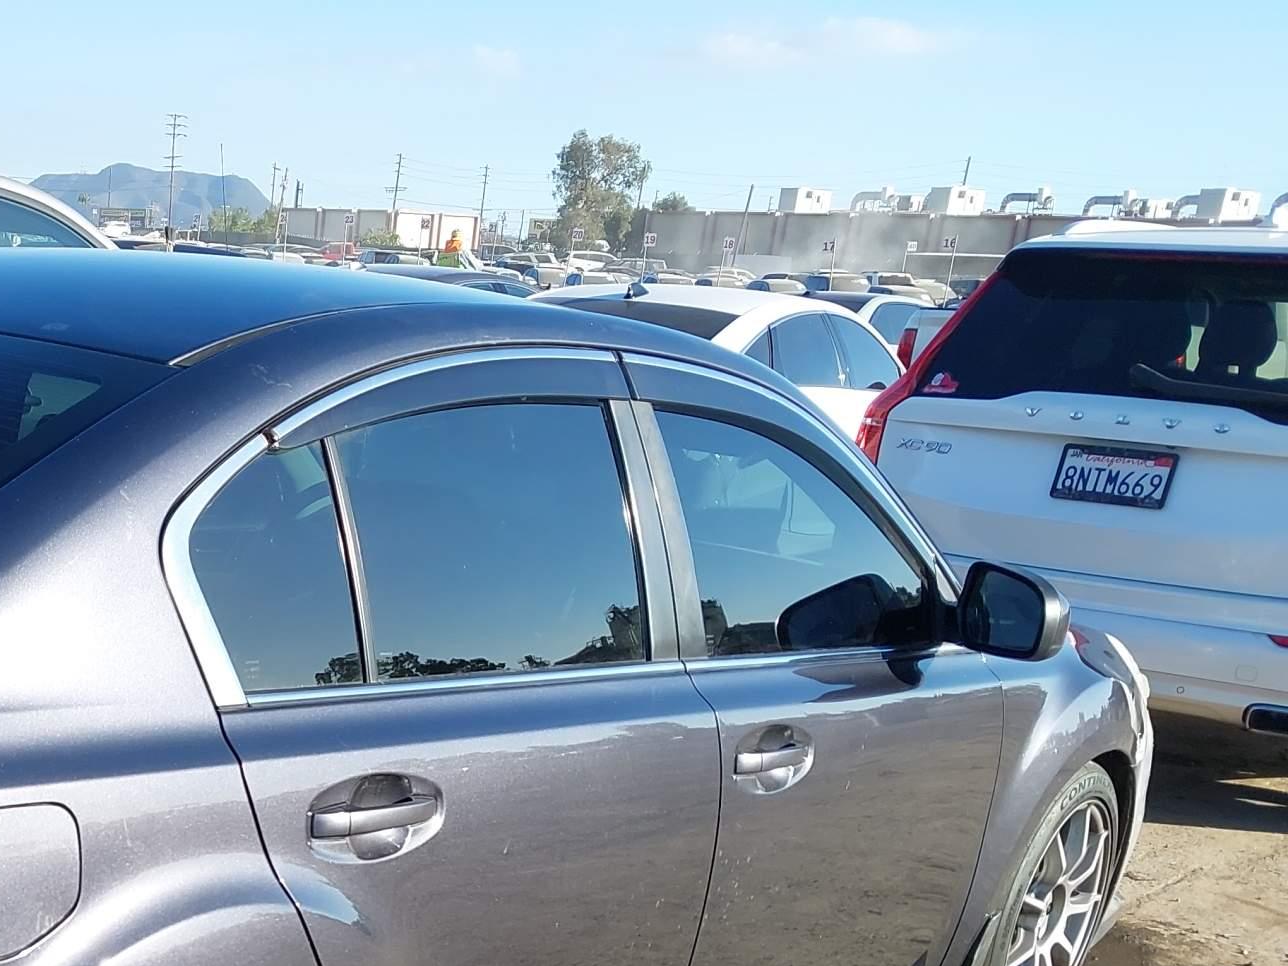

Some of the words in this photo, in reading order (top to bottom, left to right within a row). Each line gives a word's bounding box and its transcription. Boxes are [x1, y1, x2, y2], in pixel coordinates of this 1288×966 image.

[345, 215, 354, 224] 23
[572, 229, 583, 240] 20
[645, 234, 656, 244] 19
[723, 239, 734, 249] 18
[822, 241, 835, 253] 17
[943, 238, 956, 248] 16
[1061, 465, 1163, 500] 8NTM669
